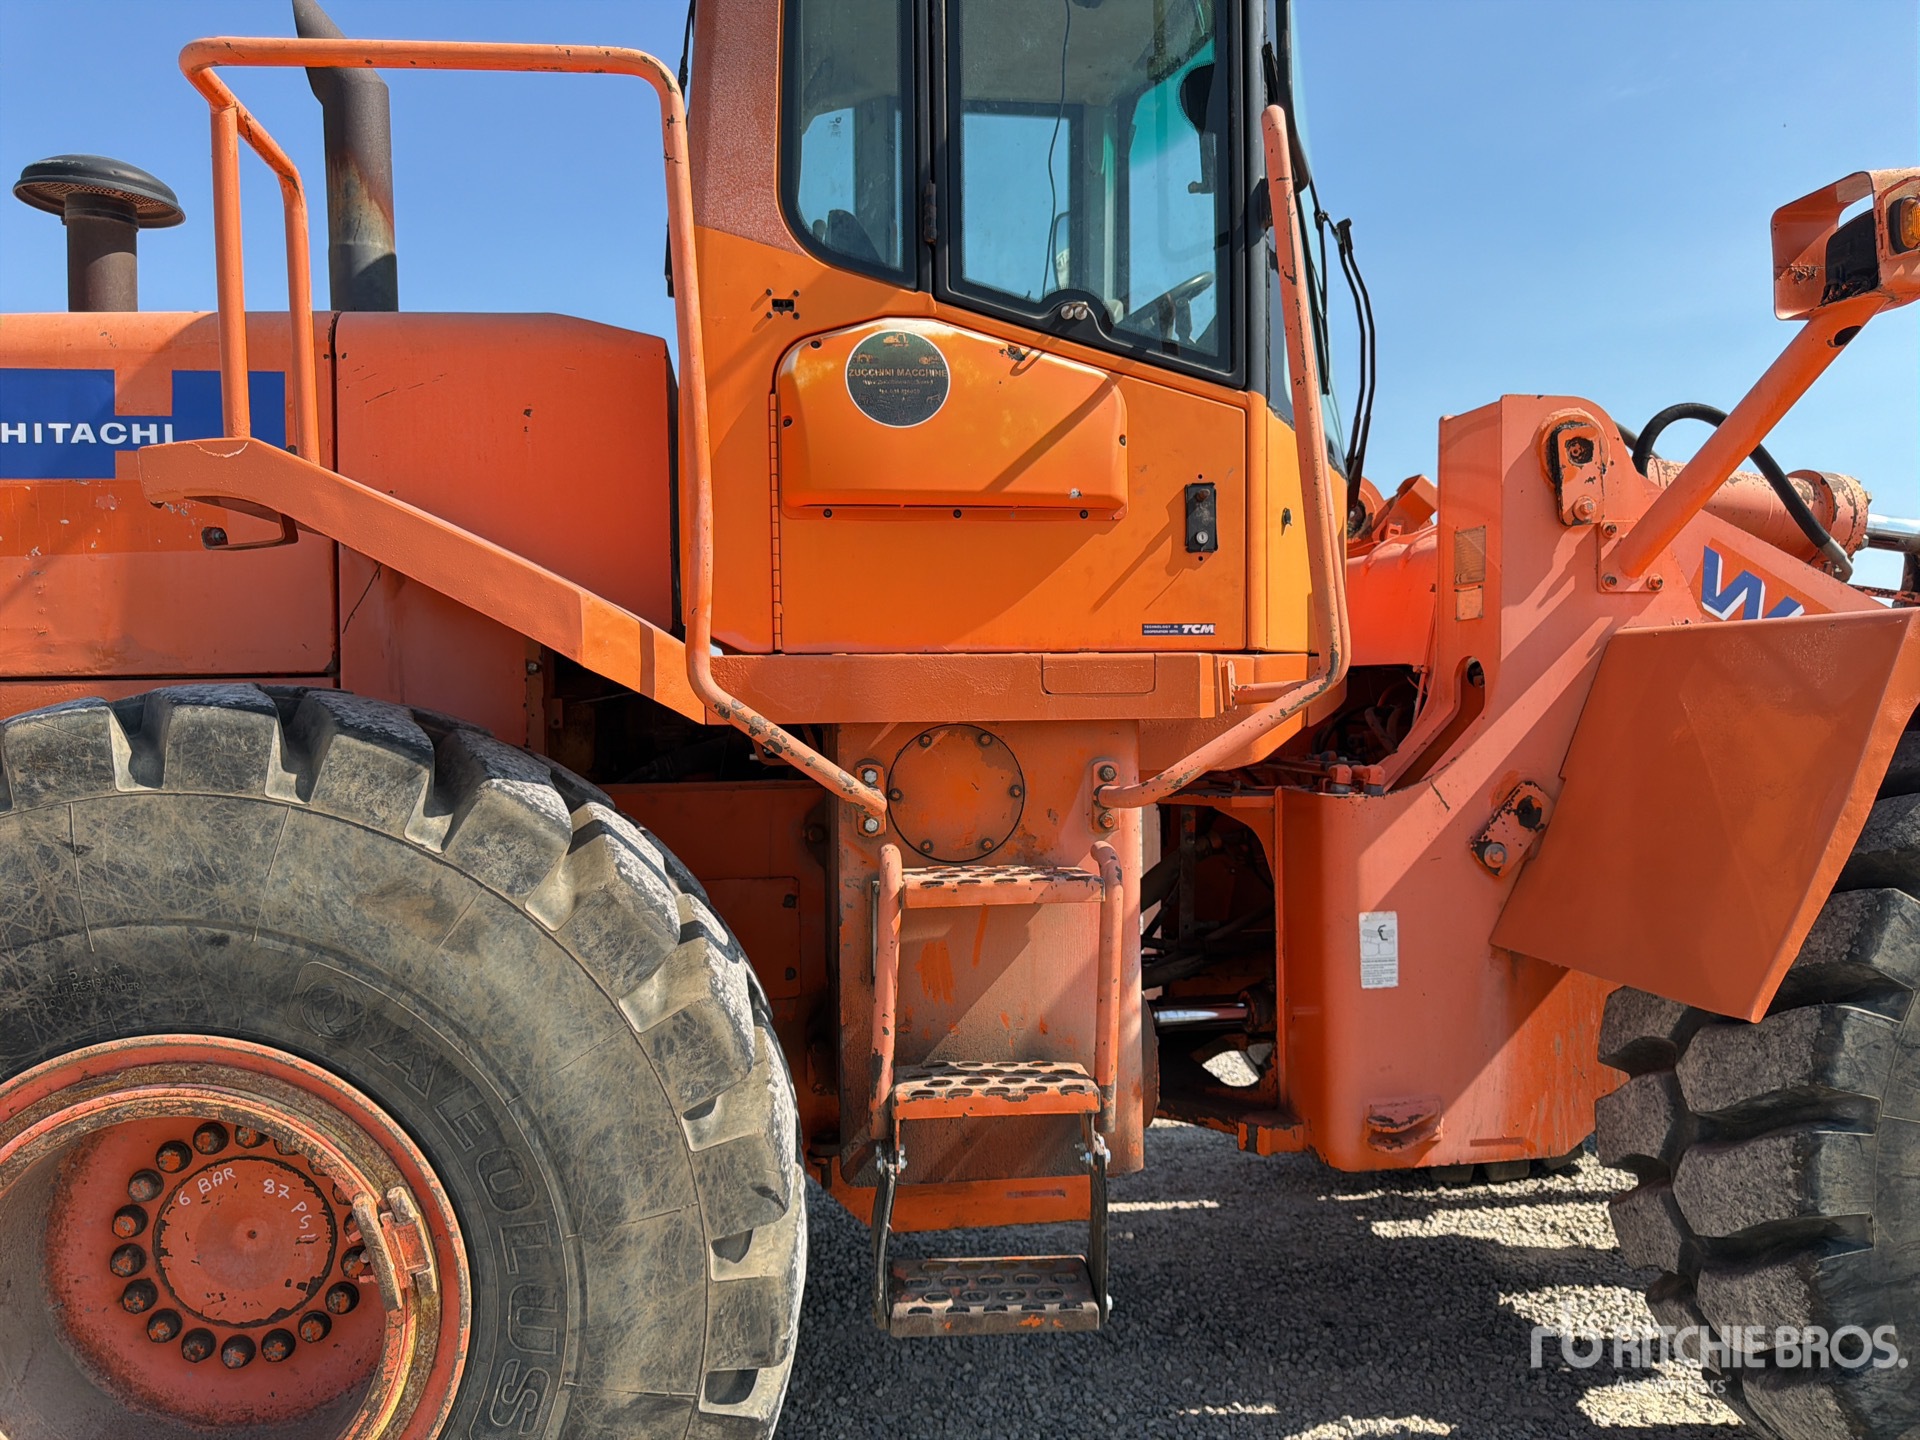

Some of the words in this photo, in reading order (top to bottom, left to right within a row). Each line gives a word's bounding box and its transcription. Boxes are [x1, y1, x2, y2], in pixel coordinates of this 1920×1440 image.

[848, 368, 894, 377] ZUCCHINI
[897, 368, 947, 377] MACCHINE
[1, 422, 174, 445] HITACHI
[1182, 624, 1214, 634] TCM
[178, 1190, 191, 1206] 6
[197, 1167, 237, 1195] BAR
[262, 1178, 291, 1200] 87
[363, 1028, 561, 1437] AEOLUS
